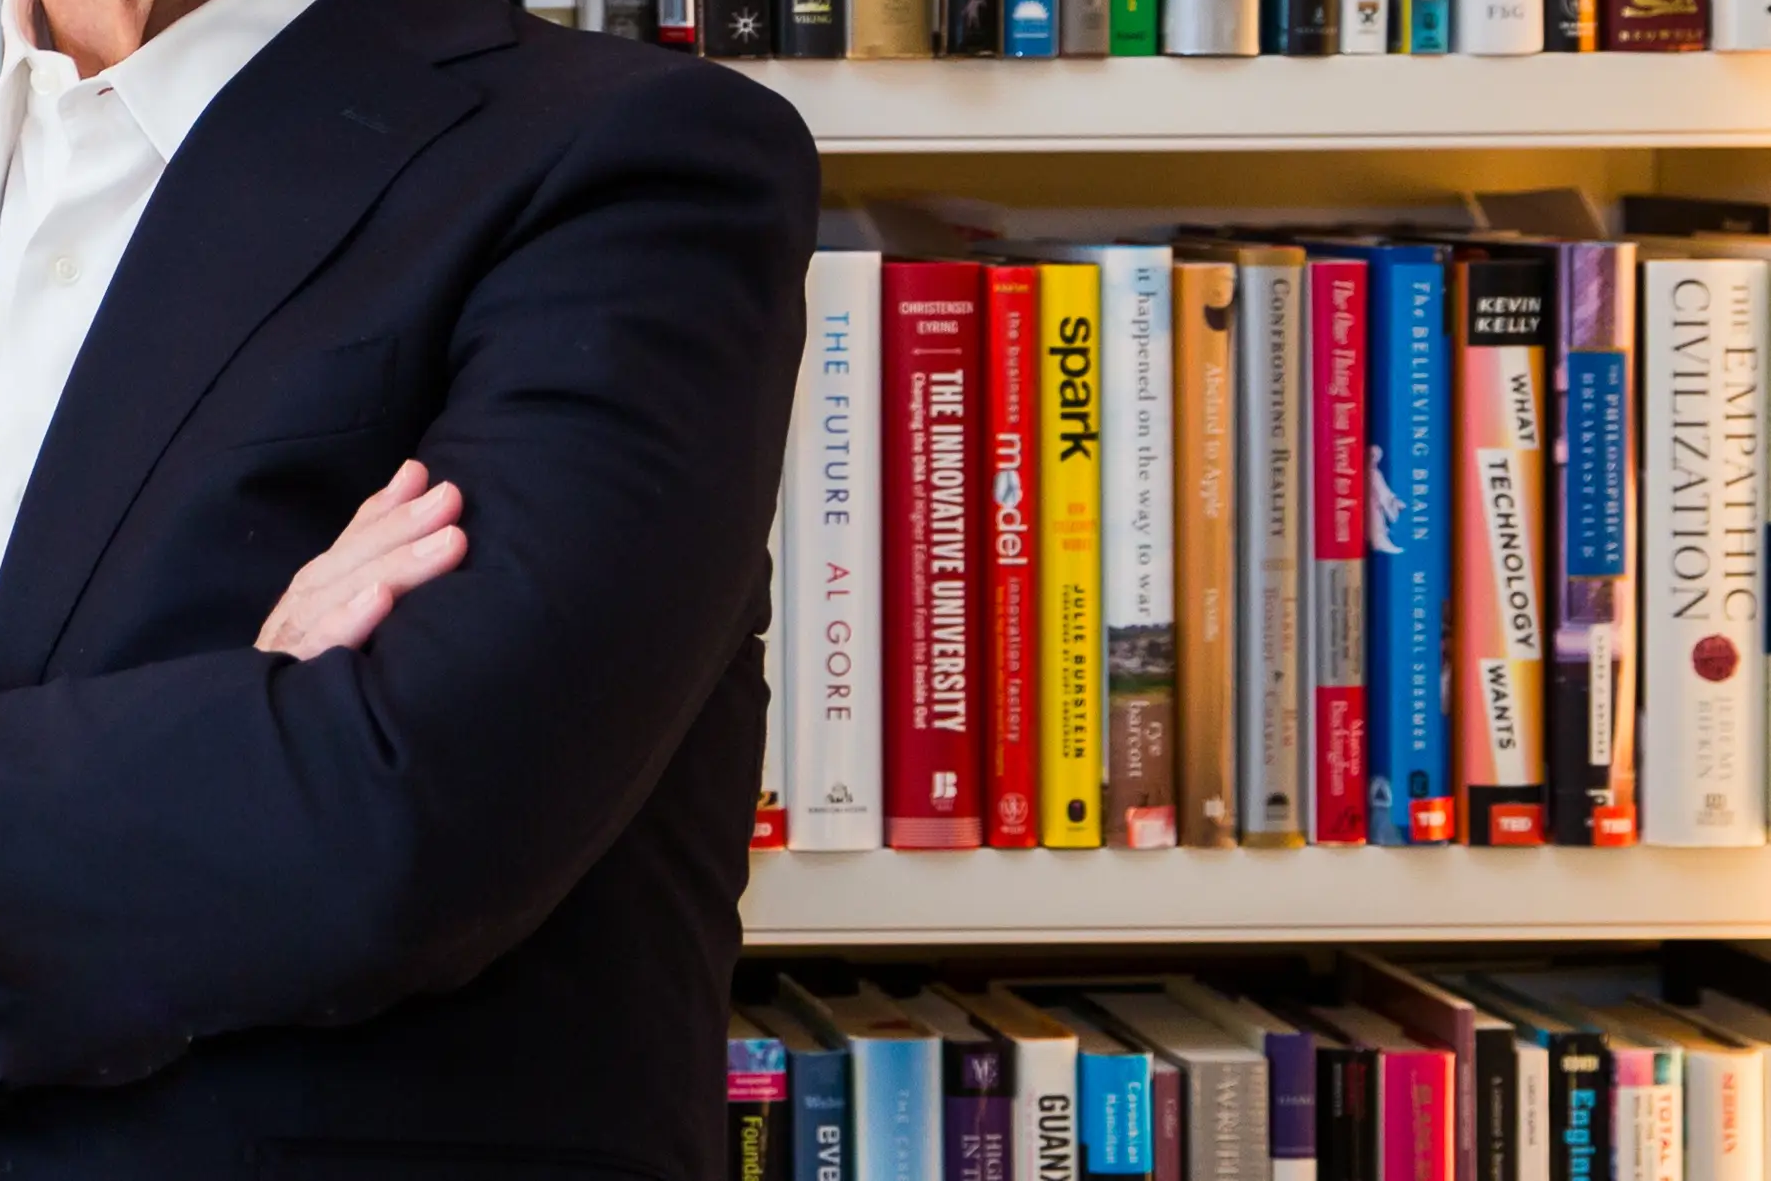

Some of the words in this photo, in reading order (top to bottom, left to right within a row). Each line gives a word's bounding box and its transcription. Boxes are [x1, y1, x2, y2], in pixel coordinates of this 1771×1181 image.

[825, 312, 849, 375] THE
[1476, 317, 1541, 333] KELLY
[1479, 298, 1542, 313] KEVIN
[932, 369, 964, 418] THE
[1049, 317, 1098, 463] spark
[1510, 374, 1536, 444] WHAT
[825, 395, 849, 525] FUTURE
[931, 423, 964, 573] INNOVATIVE
[1672, 279, 1710, 620] CIVILIZATION
[1724, 347, 1757, 622] EMPATHIC
[826, 562, 849, 601] AL
[1488, 458, 1536, 650] TECHNOLOGY
[826, 621, 851, 721] GORE
[933, 581, 966, 732] UNIVERSITY
[1488, 664, 1516, 751] WANTS
